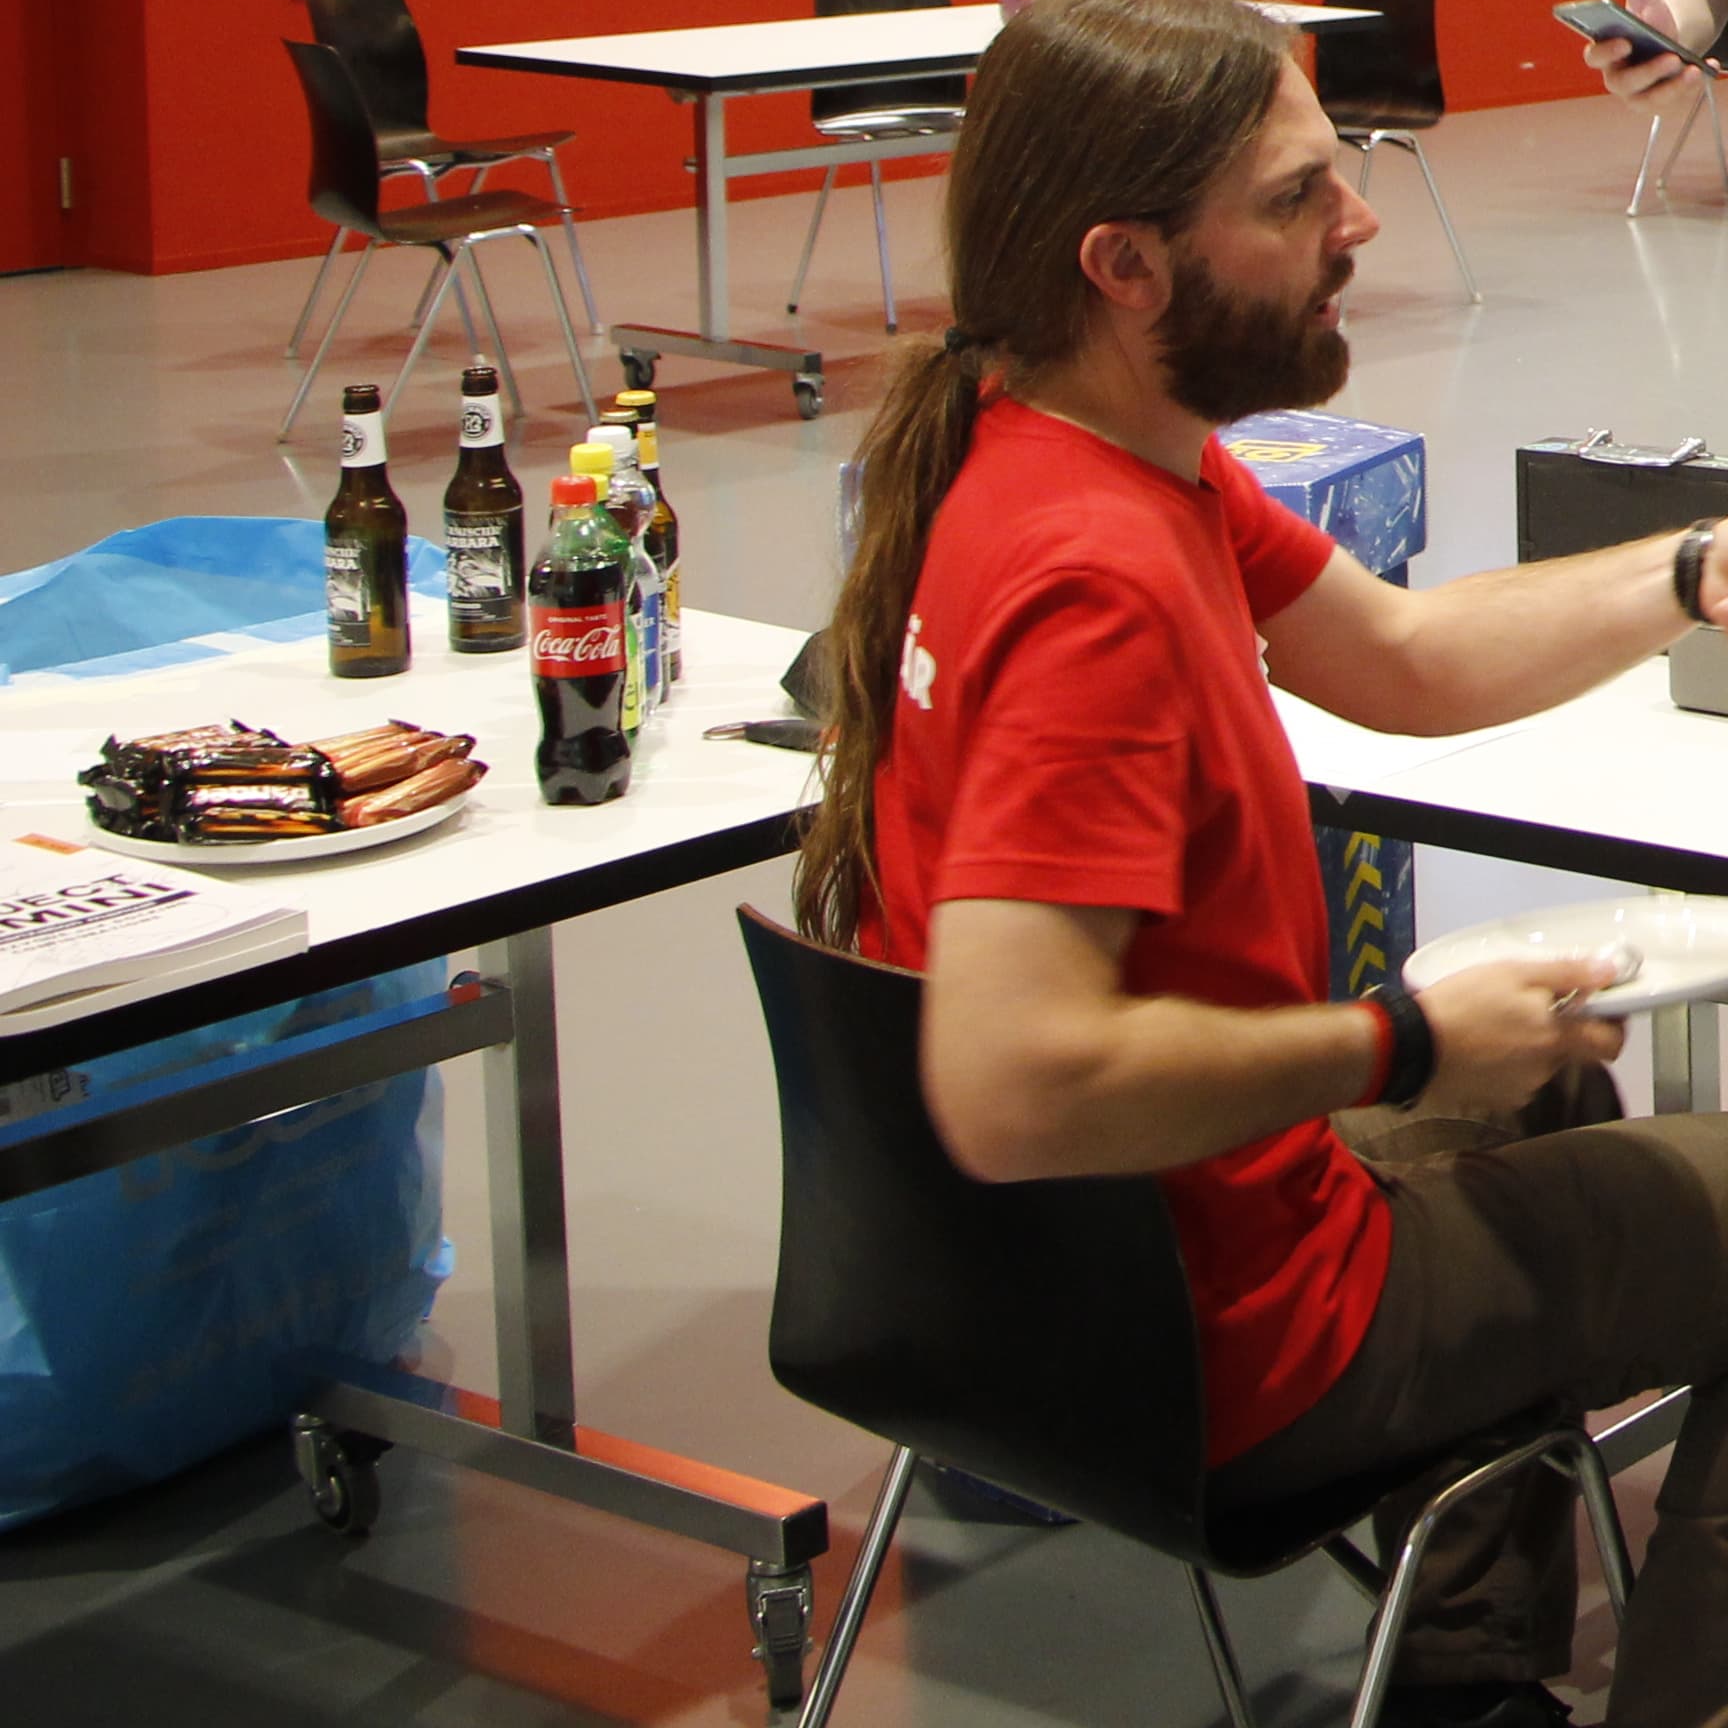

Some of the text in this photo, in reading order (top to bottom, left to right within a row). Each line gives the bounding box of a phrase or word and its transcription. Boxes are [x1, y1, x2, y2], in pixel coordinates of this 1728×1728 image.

[548, 614, 609, 624] ORIGINAL TASTE
[533, 624, 621, 663] Coca-Cola
[0, 872, 134, 915] JECT
[0, 881, 176, 929] MINI
